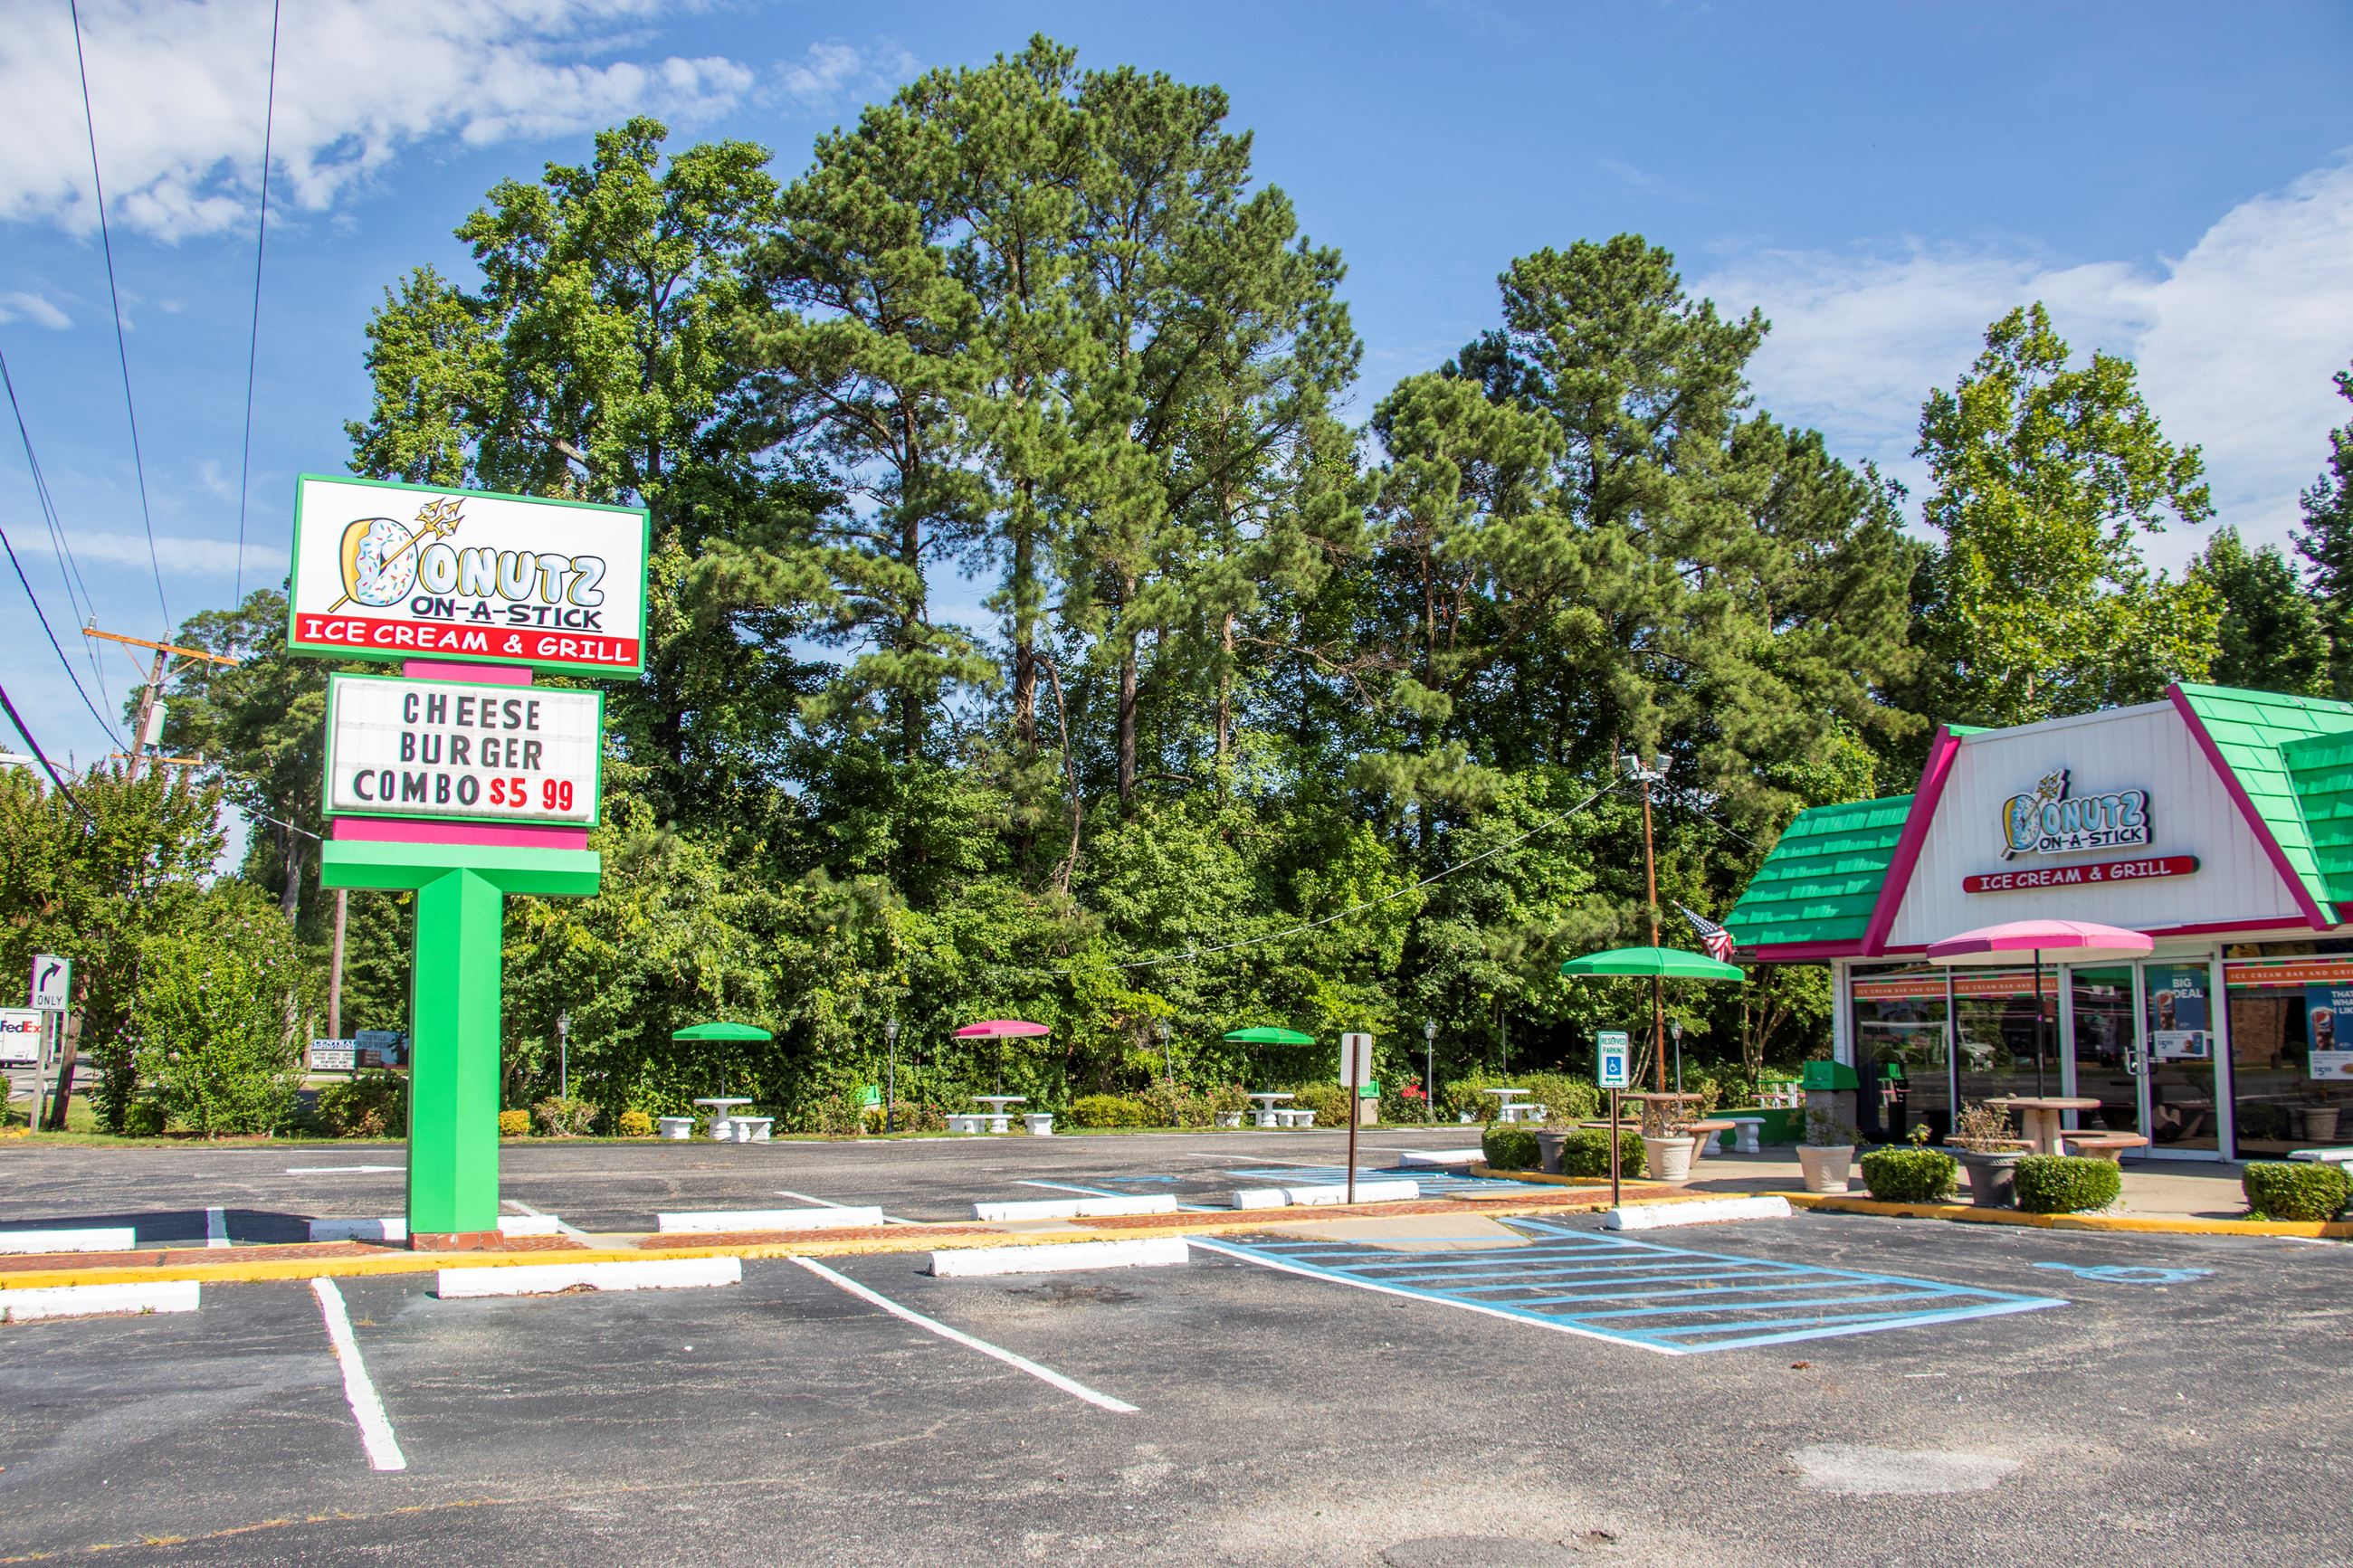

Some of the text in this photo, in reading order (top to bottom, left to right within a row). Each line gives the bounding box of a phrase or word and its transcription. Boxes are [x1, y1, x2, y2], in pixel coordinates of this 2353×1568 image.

[410, 595, 603, 631] ON-A-STICK
[304, 618, 633, 662] ICE CREAM & GRILL
[403, 692, 540, 730] CHEESE
[400, 731, 543, 770] BURGER
[353, 769, 573, 812] COMBO $5 99
[2039, 827, 2143, 850] ON-A-STICK
[1980, 860, 2172, 890] ICE CREAM & GRILL
[2172, 977, 2192, 988] BIG
[2174, 988, 2204, 999] DEAL
[38, 995, 62, 1005] ONLY
[0, 1021, 42, 1032] FedEx
